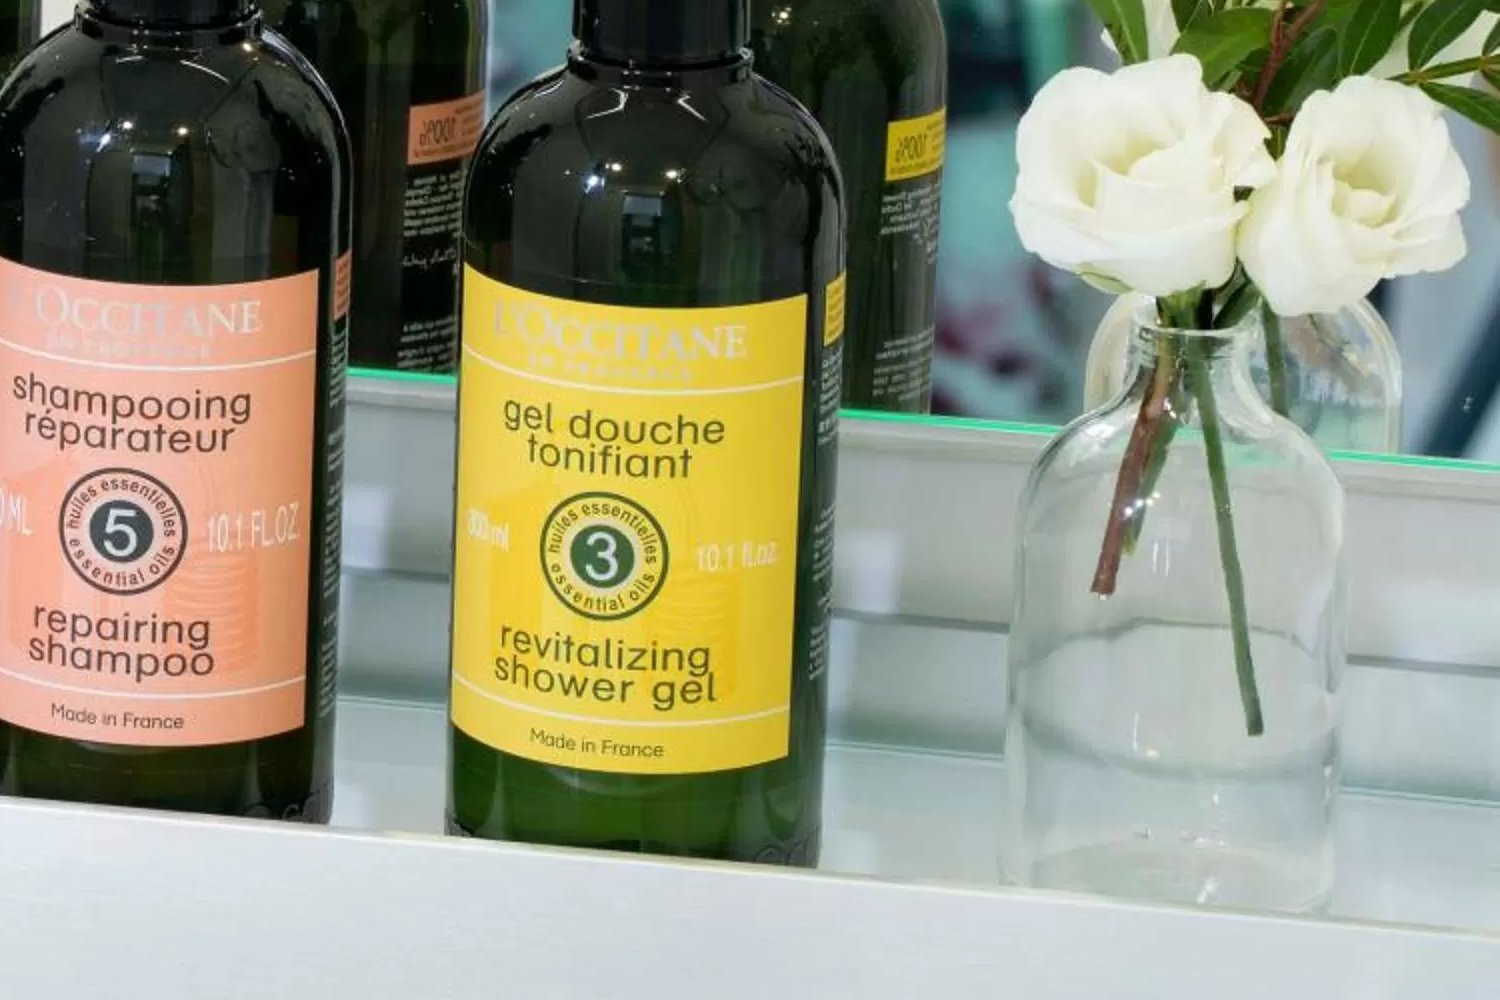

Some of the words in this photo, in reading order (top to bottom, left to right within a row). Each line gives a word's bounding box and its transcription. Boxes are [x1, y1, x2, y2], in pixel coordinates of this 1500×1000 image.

[12, 280, 262, 337] OCCITANE
[12, 372, 252, 425] shampooing
[504, 399, 553, 433] gel
[569, 408, 725, 445] douche
[25, 406, 235, 454] réparateur
[527, 431, 693, 478] tonifiant
[66, 484, 98, 530] huiles
[101, 478, 177, 538] essentielles
[103, 507, 138, 557] 5
[206, 513, 243, 553] 10.1
[548, 508, 579, 554] huiles
[581, 503, 657, 565] essentielles
[585, 531, 619, 581] 3
[69, 538, 145, 587] essential
[149, 545, 175, 575] oils
[551, 563, 625, 613] essential
[629, 573, 655, 601] oils
[34, 604, 212, 651] repairing
[500, 623, 710, 678] revitalizing
[28, 634, 215, 683] shampoo
[494, 654, 636, 703] shower
[652, 672, 717, 713] gel
[51, 702, 97, 725] Made
[103, 711, 118, 727] in
[123, 711, 184, 730] France
[530, 727, 577, 752] Made
[581, 737, 596, 754] in
[601, 738, 665, 758] France
